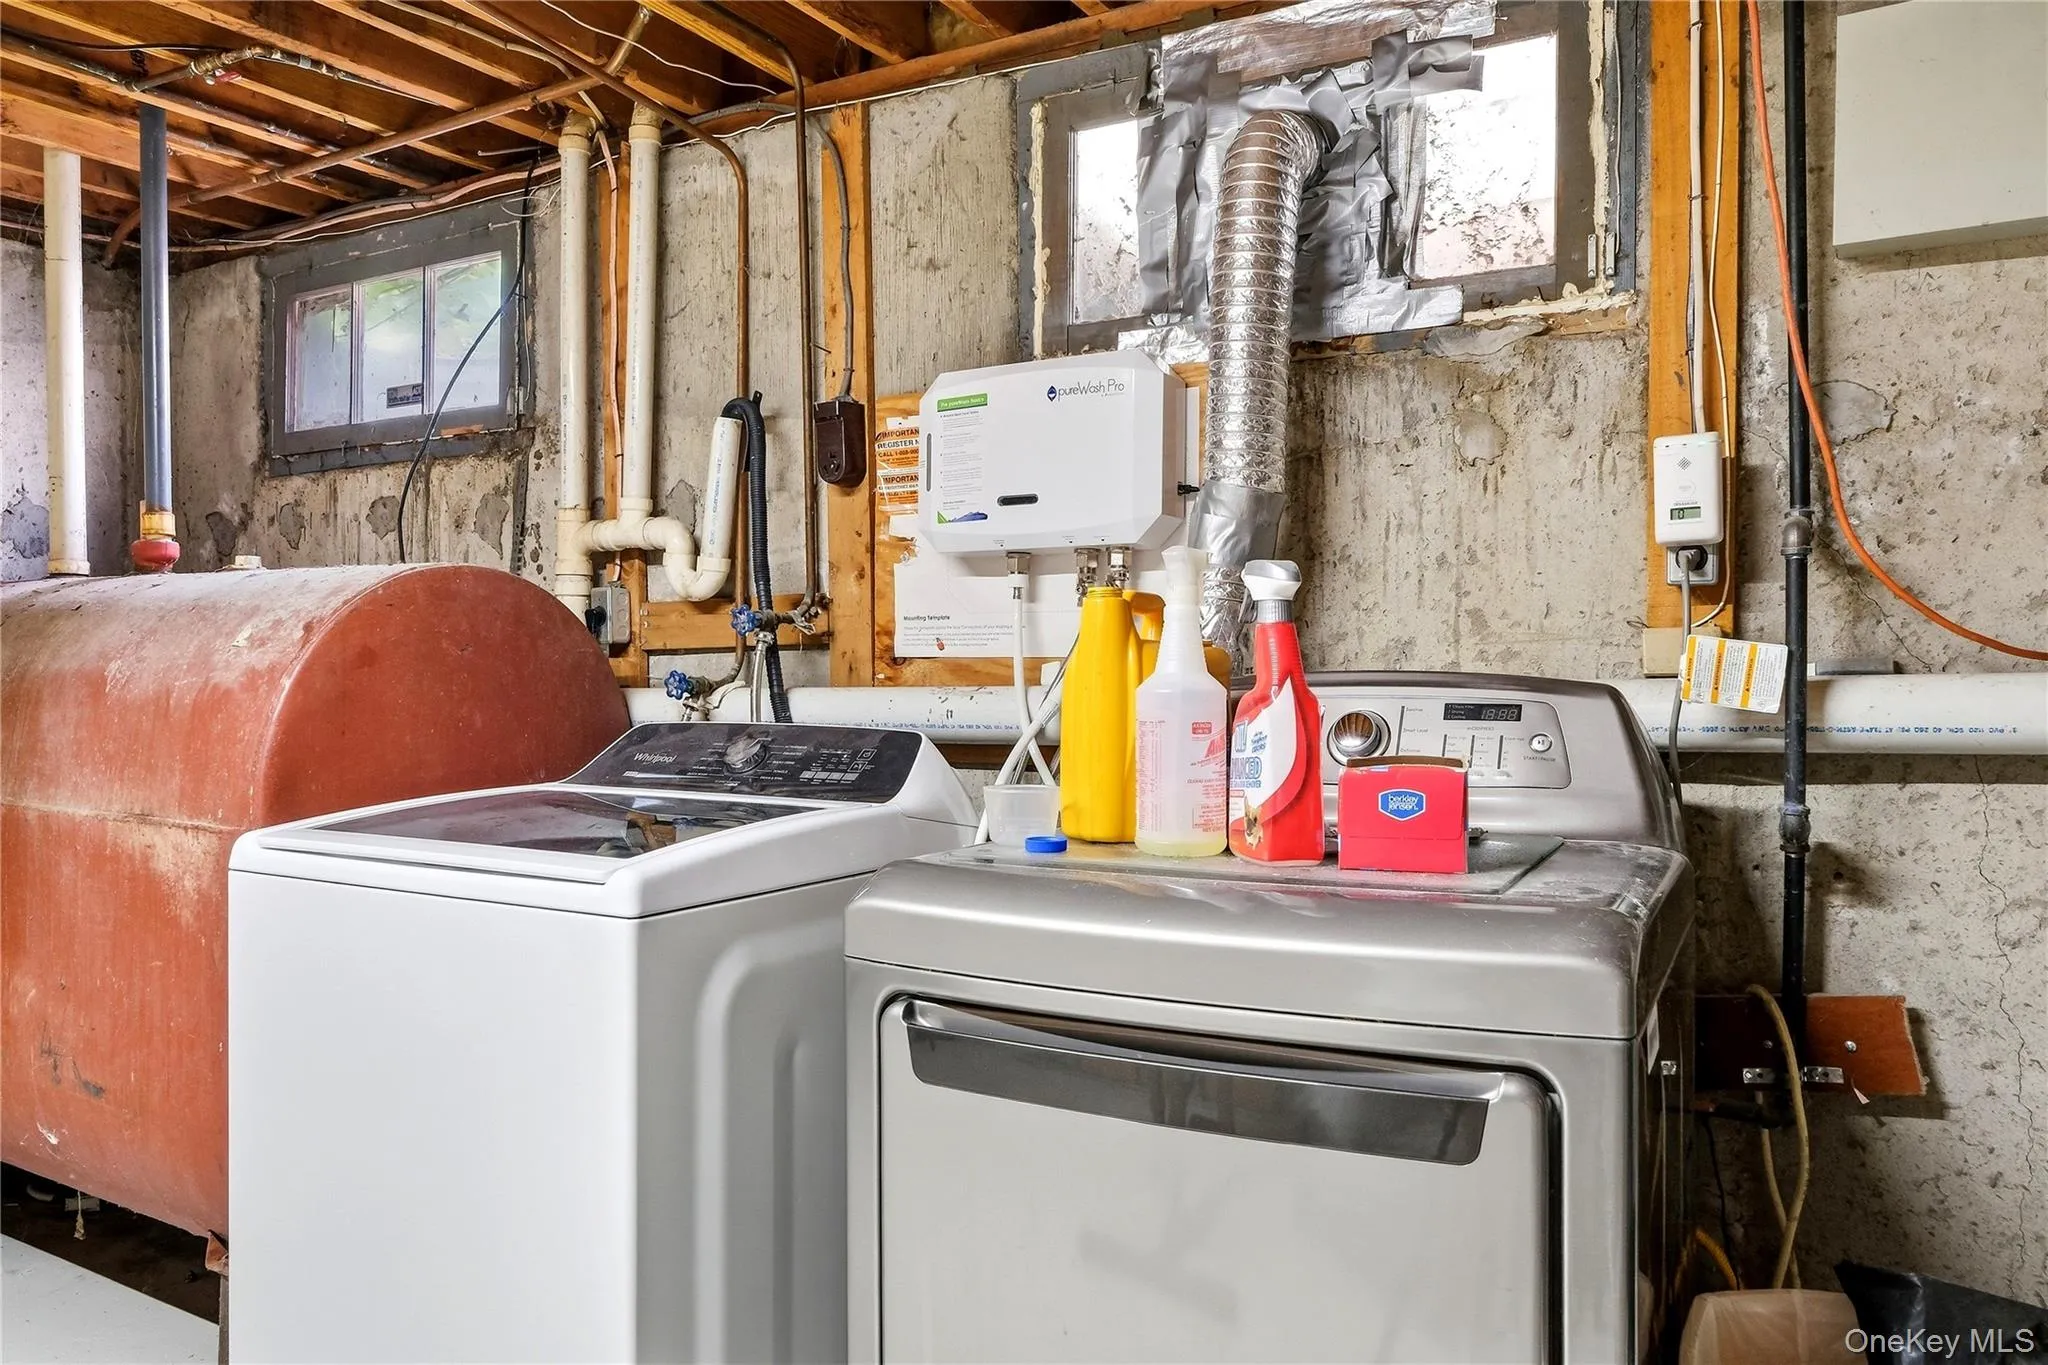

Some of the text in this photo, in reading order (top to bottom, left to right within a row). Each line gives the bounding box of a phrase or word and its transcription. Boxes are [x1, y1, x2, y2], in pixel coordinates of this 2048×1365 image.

[1058, 378, 1125, 402] pureWash Pro
[877, 440, 914, 450] REGISTER
[878, 450, 893, 458] CALL
[633, 752, 678, 764] Whirlpool
